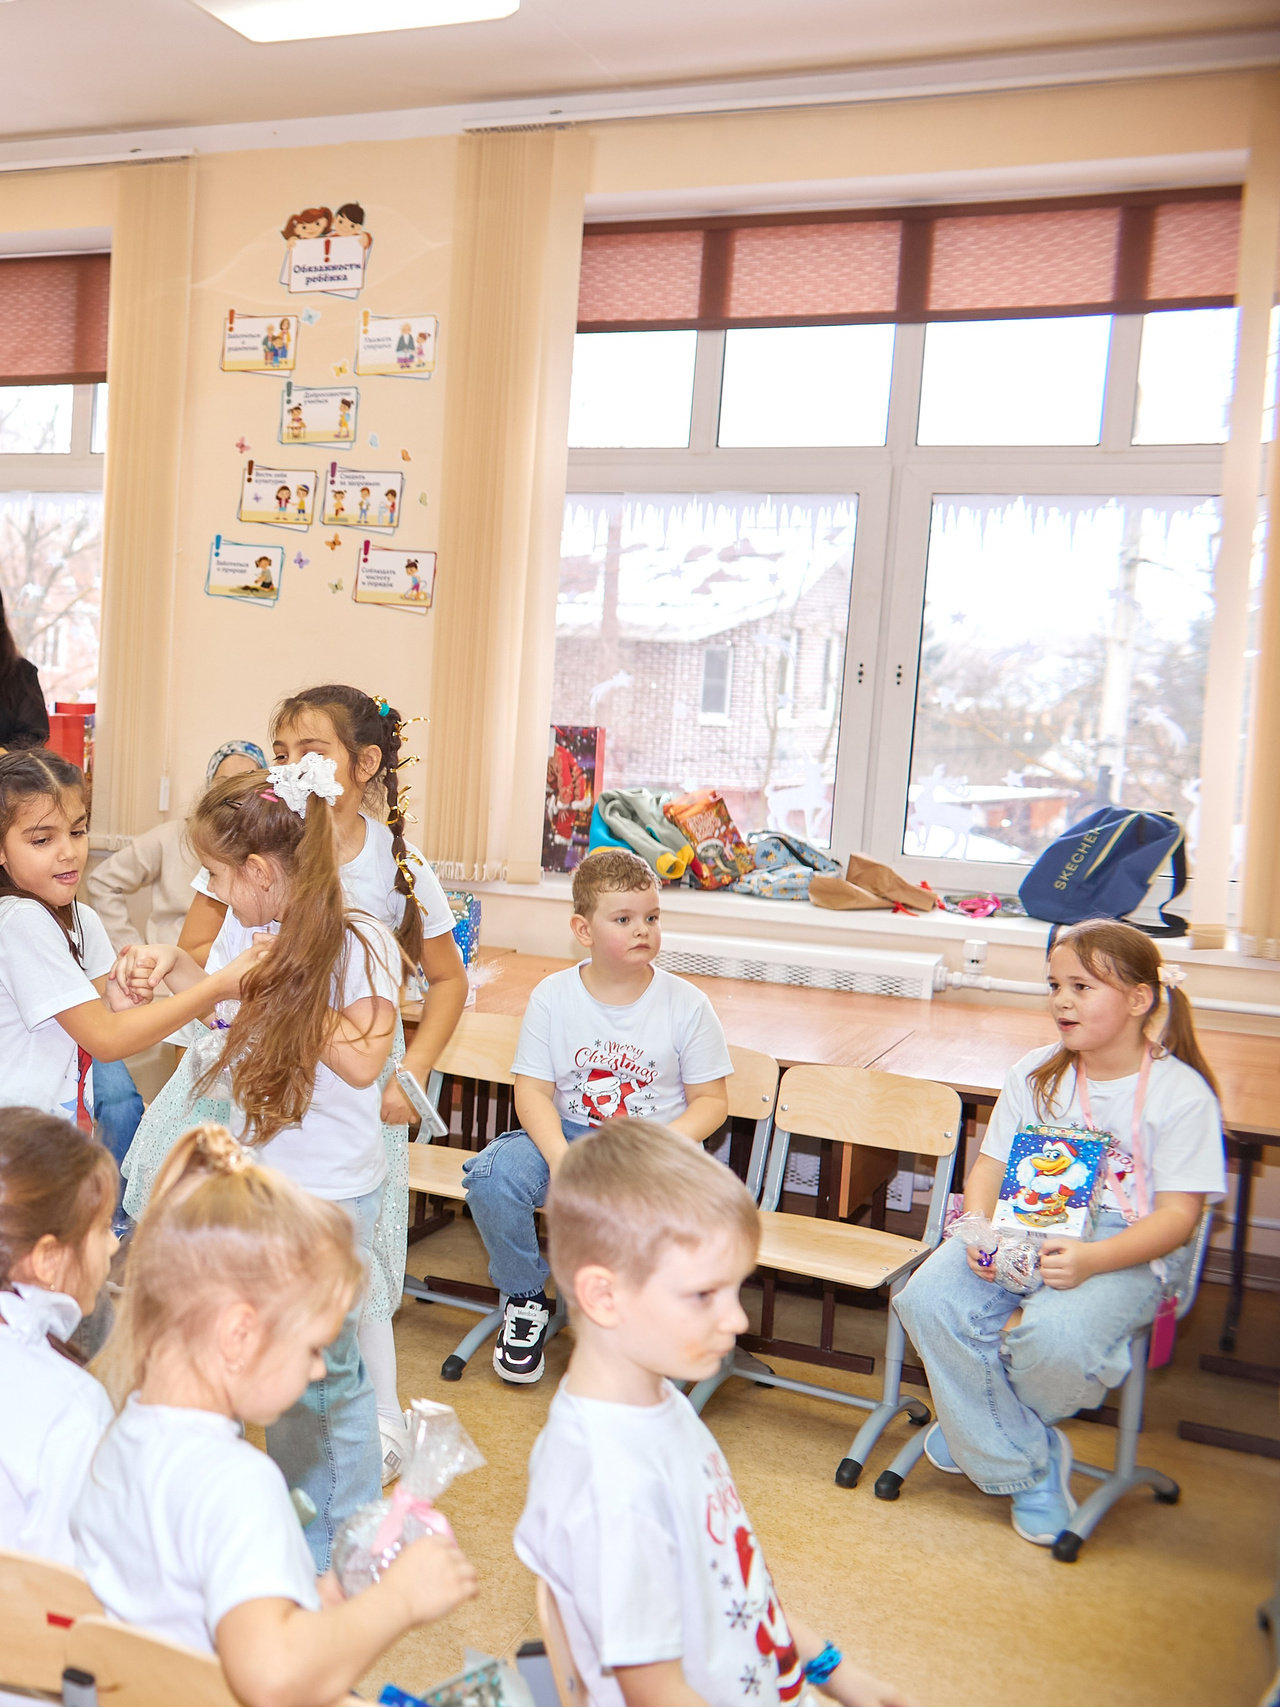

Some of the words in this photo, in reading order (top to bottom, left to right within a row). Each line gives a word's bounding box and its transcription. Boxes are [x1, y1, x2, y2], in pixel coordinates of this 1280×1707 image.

[293, 263, 361, 273] Обязанности
[604, 1041, 644, 1060] Merry
[575, 1047, 658, 1085] Christmas
